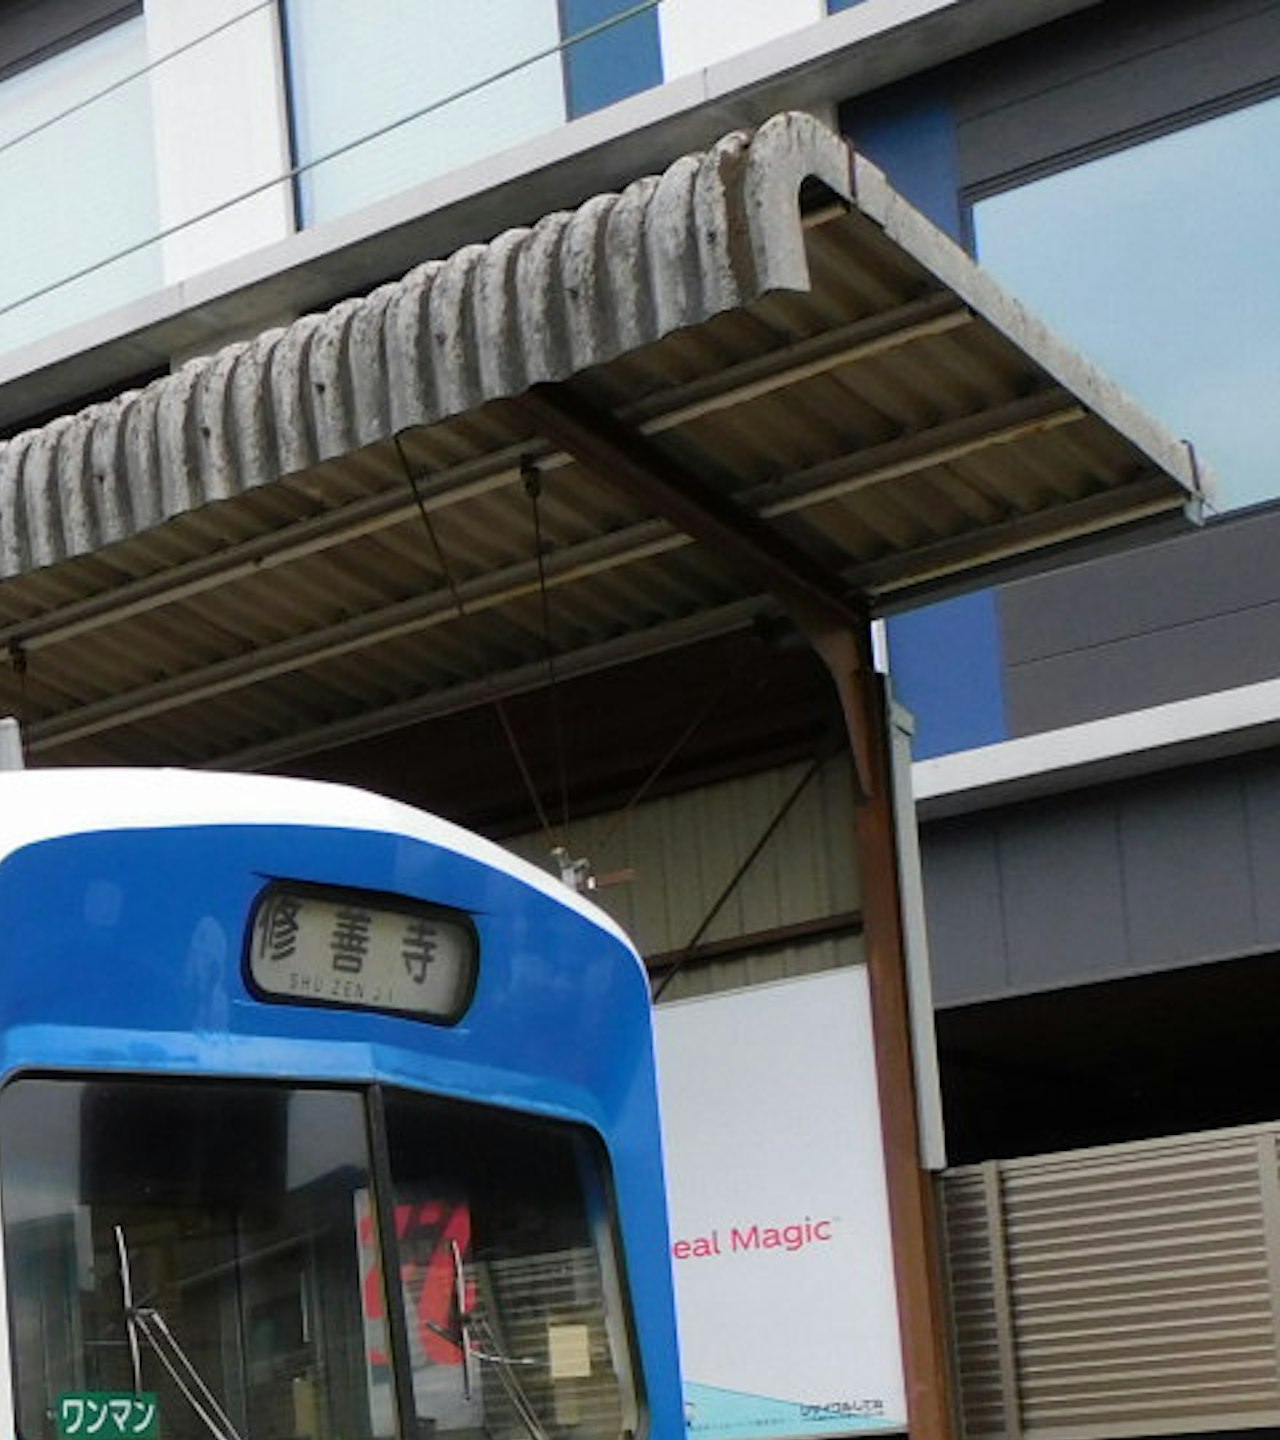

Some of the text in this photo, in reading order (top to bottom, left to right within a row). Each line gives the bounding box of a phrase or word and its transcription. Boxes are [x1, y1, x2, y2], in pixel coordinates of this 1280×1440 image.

[258, 898, 438, 984] 修善寺
[673, 1215, 832, 1260] eal Magic
[62, 1399, 155, 1434] ワンマン
